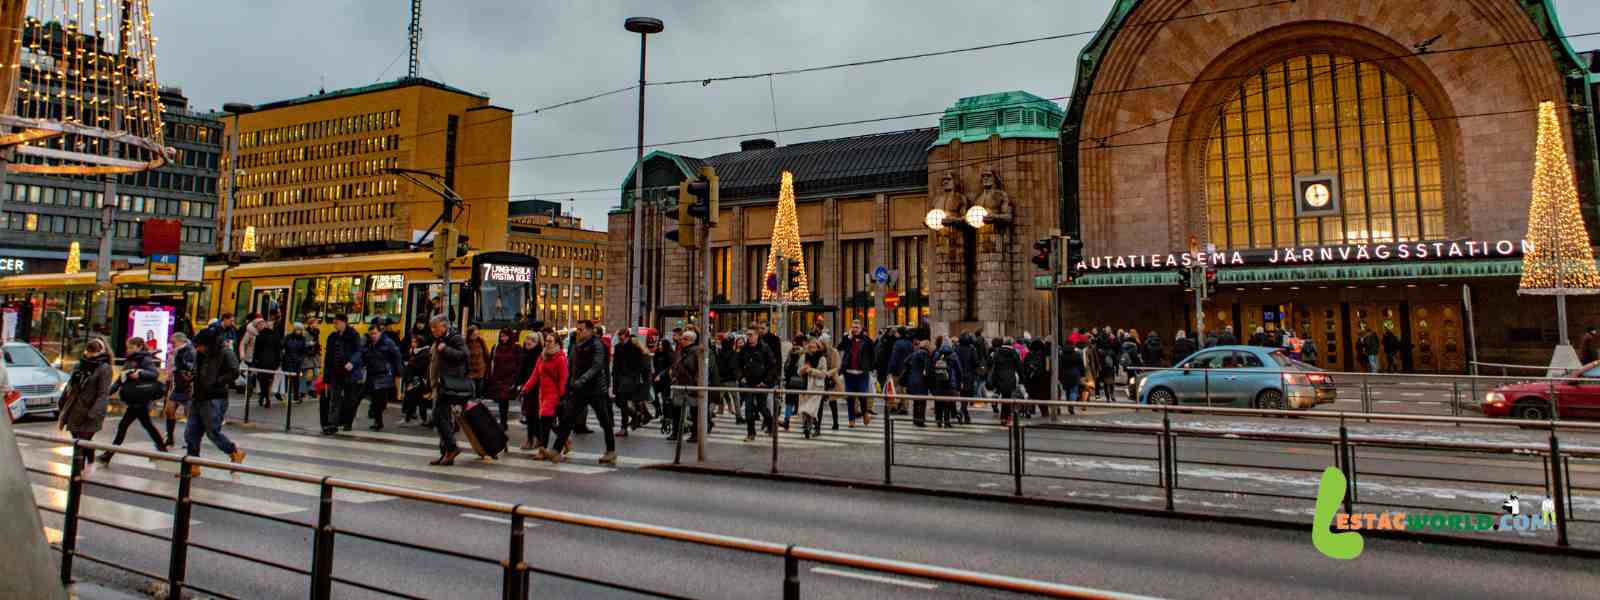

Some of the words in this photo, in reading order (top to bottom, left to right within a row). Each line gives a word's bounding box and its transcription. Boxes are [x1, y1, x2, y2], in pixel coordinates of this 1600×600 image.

[1076, 250, 1243, 270] AUTATIEASEMA
[1268, 239, 1535, 264] JÄRNVÄGSSTATION
[483, 262, 492, 281] 7
